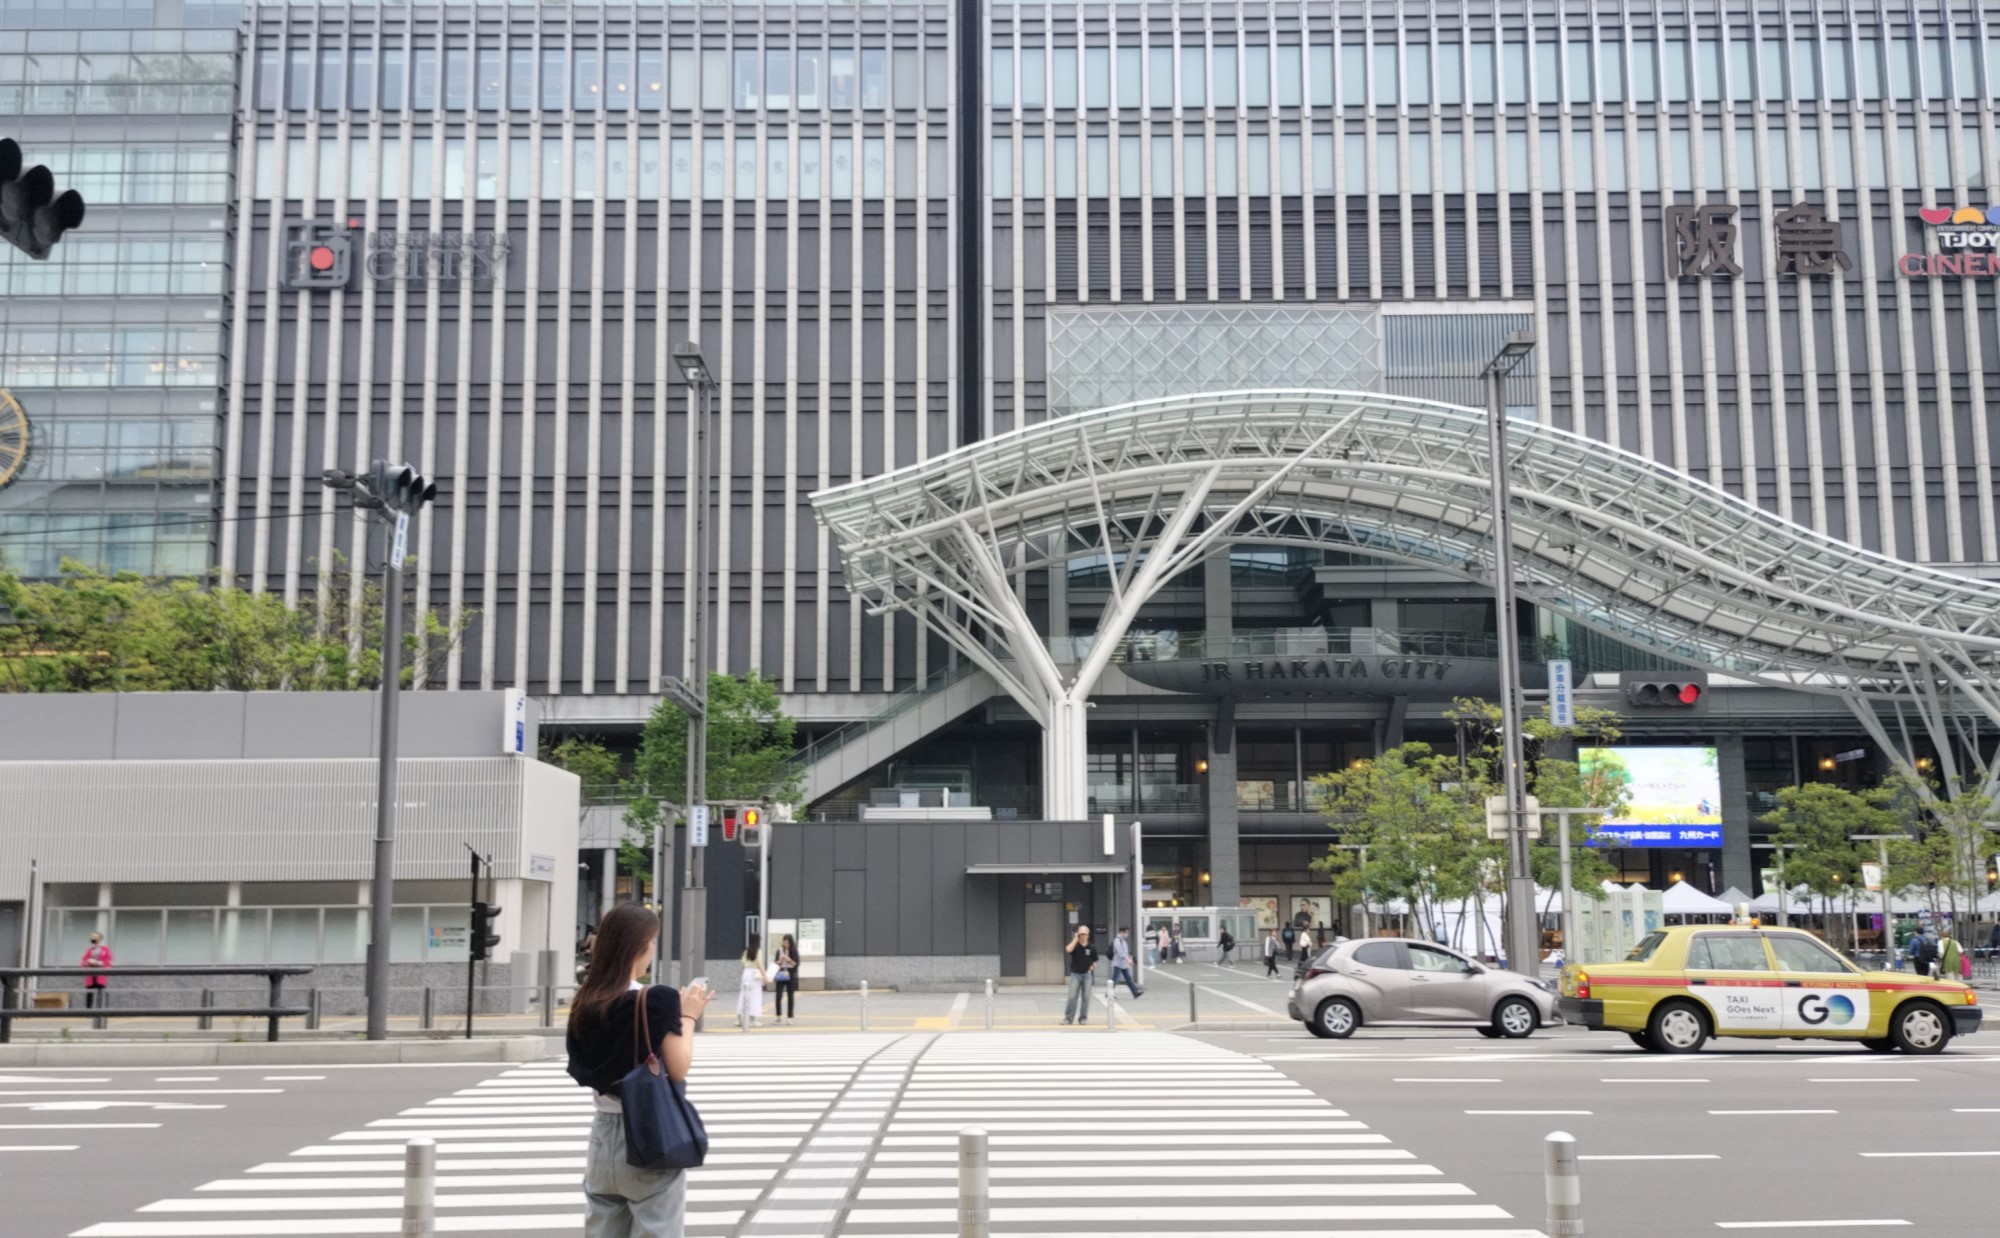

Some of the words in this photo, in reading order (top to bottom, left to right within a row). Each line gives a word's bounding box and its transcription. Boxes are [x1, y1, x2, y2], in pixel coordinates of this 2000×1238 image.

[1665, 202, 1853, 279] 阪急
[366, 249, 512, 280] CITY
[1201, 661, 1232, 683] JR
[1244, 659, 1368, 680] HAKATA
[1382, 659, 1452, 680] CITY
[1726, 1006, 1751, 1014] GOes
